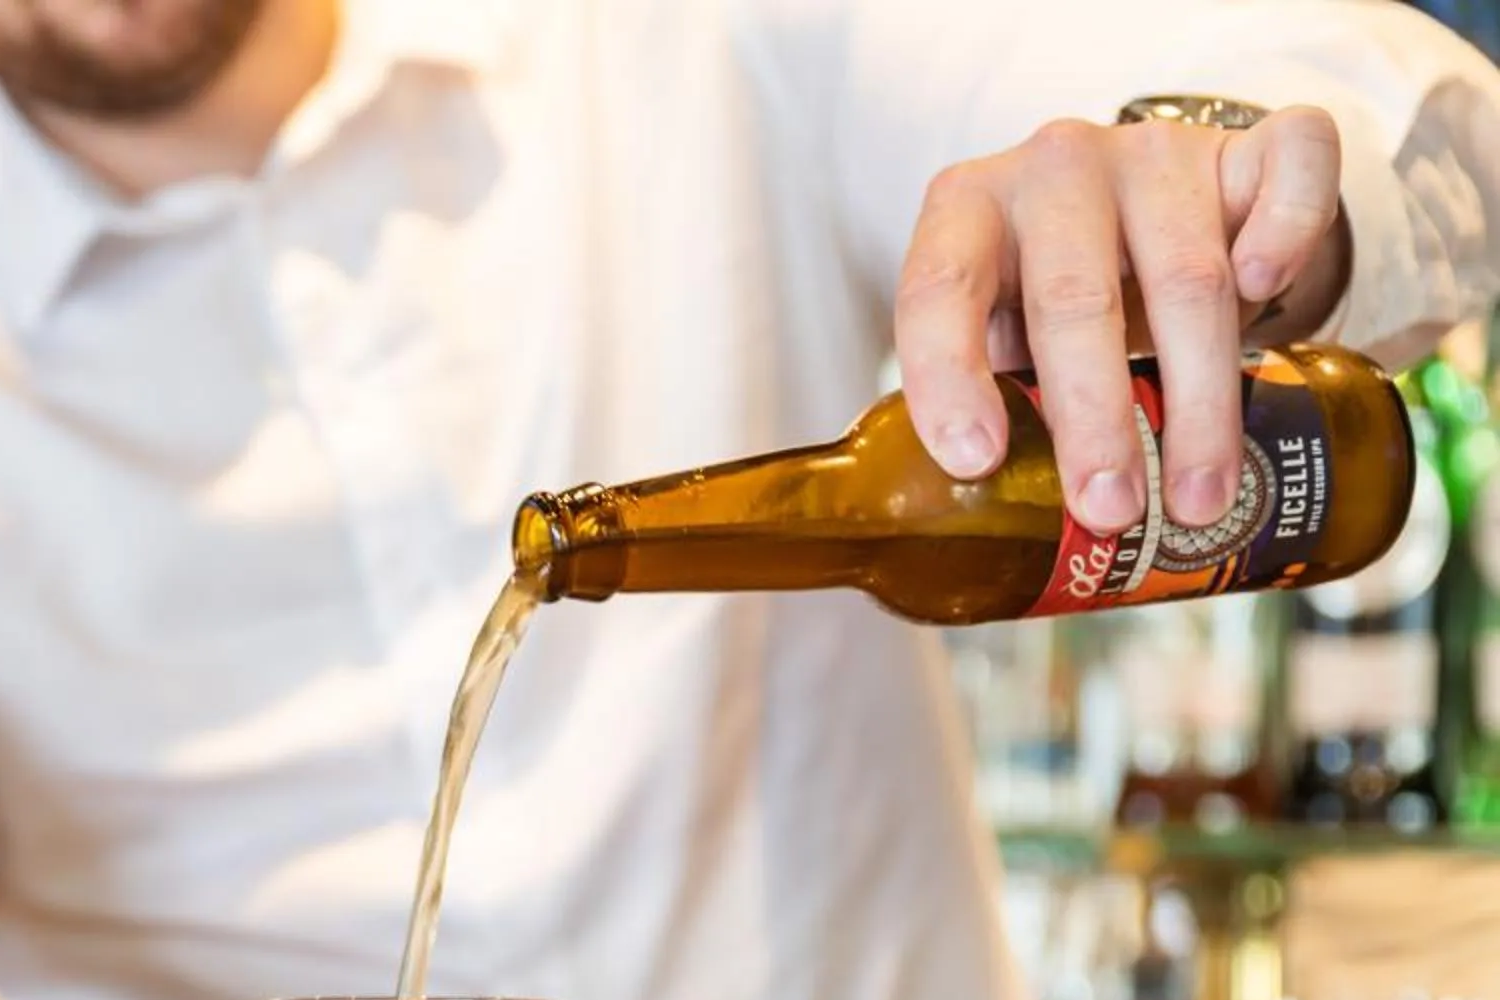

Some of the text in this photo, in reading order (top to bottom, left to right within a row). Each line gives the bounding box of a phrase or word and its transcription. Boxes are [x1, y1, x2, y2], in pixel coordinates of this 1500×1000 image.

[1310, 437, 1323, 456] IPA
[1275, 436, 1308, 538] FICELLE
[1060, 543, 1115, 598] La
